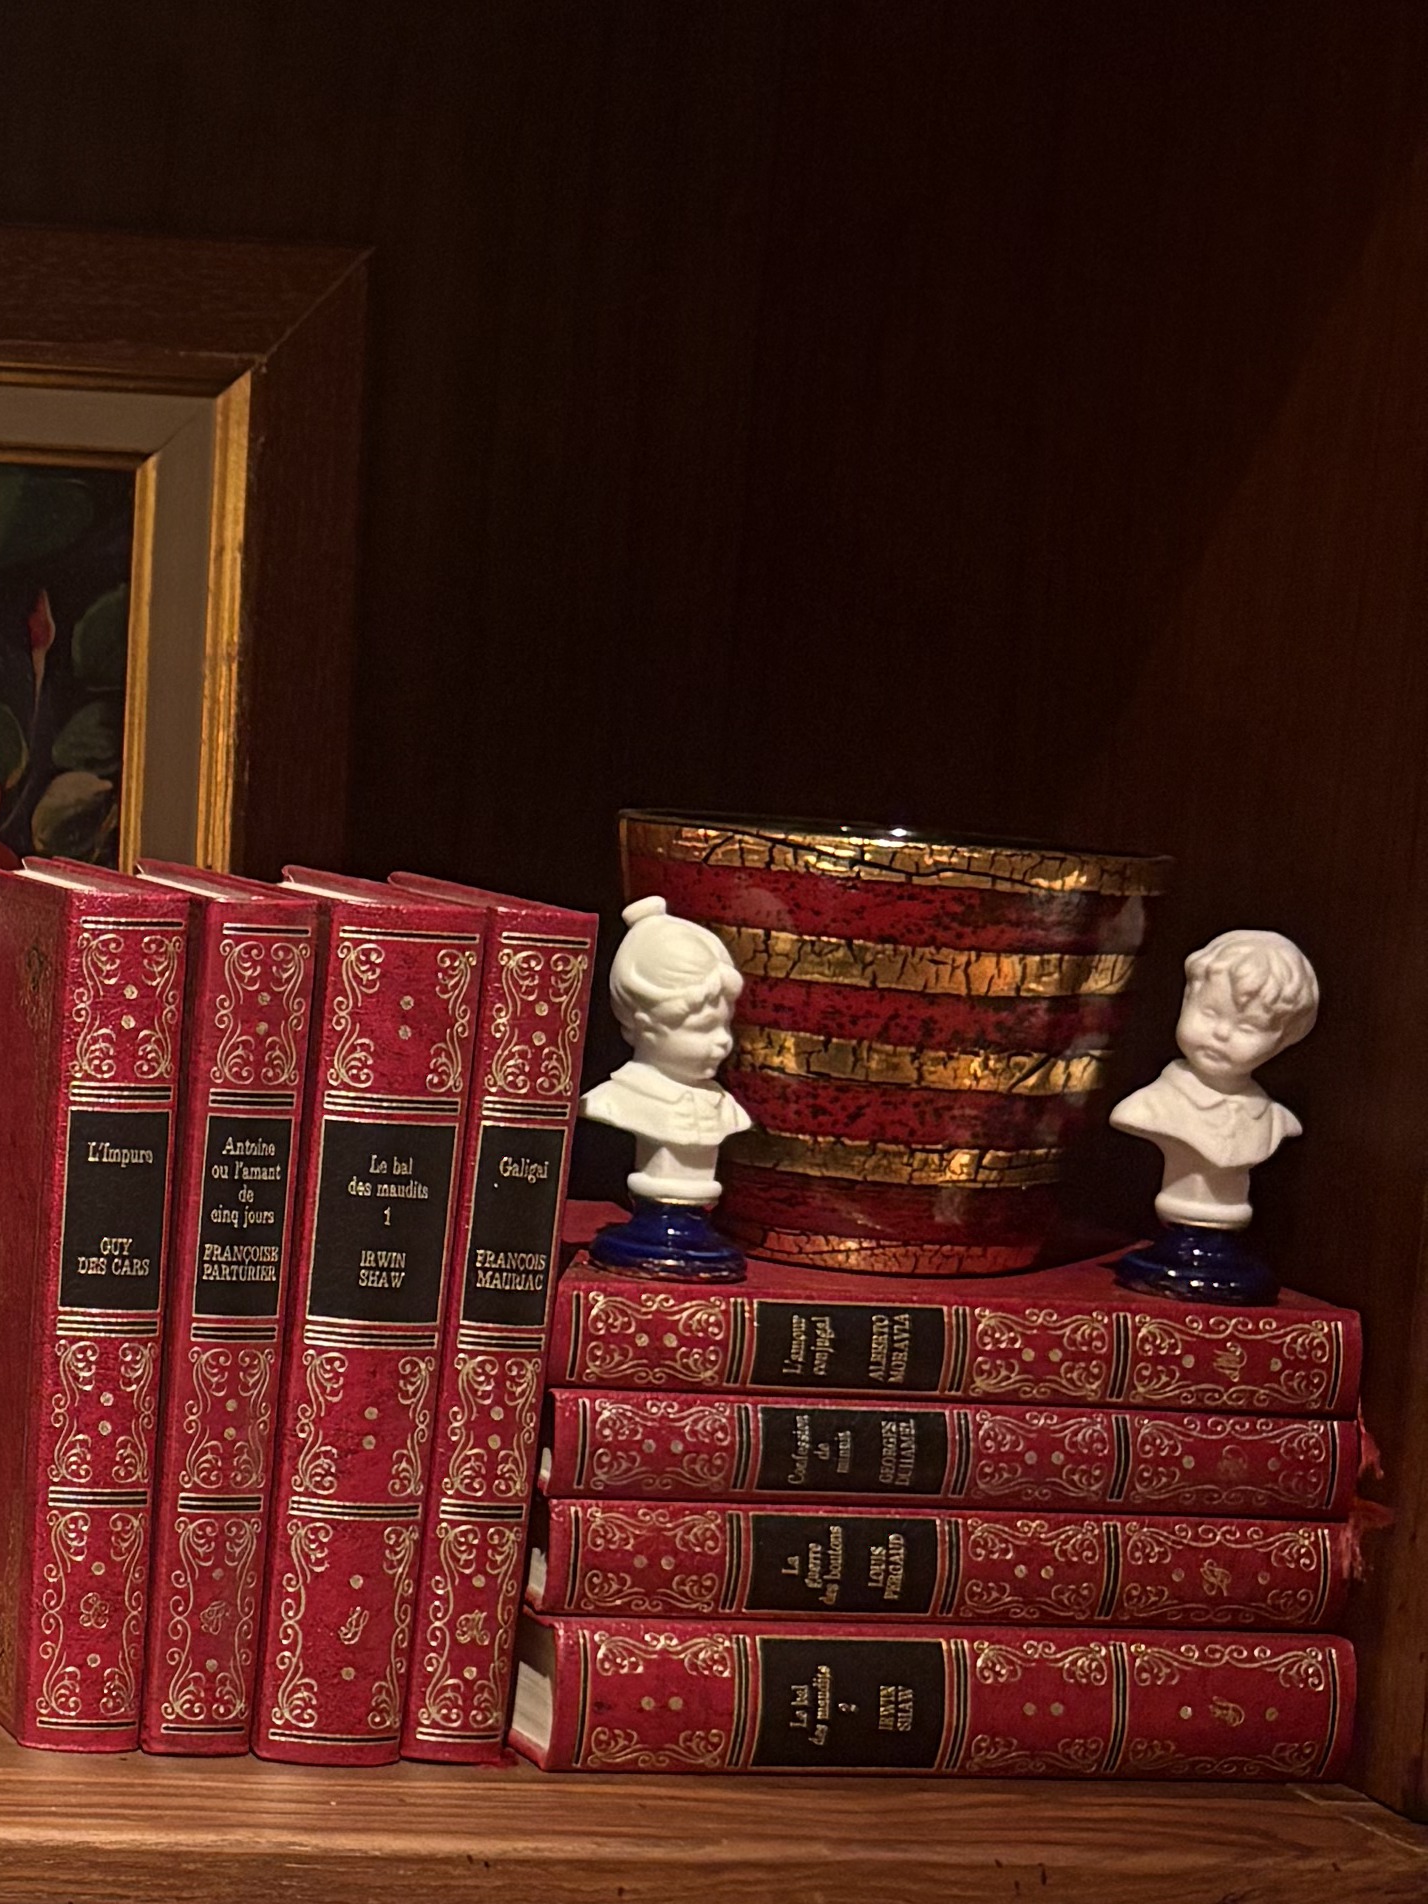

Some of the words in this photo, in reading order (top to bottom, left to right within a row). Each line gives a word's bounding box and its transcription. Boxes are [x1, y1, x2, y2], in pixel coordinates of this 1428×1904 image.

[87, 1141, 155, 1169] L'Impure
[221, 1135, 276, 1157] Antoine
[211, 1162, 230, 1180] ou
[233, 1160, 283, 1181] l'amant
[368, 1154, 389, 1174] Le
[393, 1156, 414, 1176] bal
[237, 1183, 255, 1203] de
[347, 1175, 372, 1197] des
[375, 1178, 430, 1200] maudits
[209, 1203, 240, 1230] cinq
[242, 1204, 276, 1230] jours
[383, 1205, 392, 1227] 1
[99, 1236, 134, 1257] GUY
[202, 1243, 280, 1265] FRANÇOISE
[76, 1256, 108, 1276] DES
[110, 1257, 151, 1277] CARS
[359, 1249, 407, 1270] IRWIN
[474, 1249, 549, 1272] FRANÇOIS
[201, 1262, 278, 1283] PARTURIER
[358, 1268, 407, 1290] SHAW
[474, 1269, 545, 1292] MAURIAC
[782, 1314, 806, 1374] L'amour
[809, 1315, 836, 1377] conjugal
[867, 1314, 890, 1383] ALBERTO
[887, 1313, 911, 1385] MORAVIA
[786, 1414, 810, 1486] Confession
[812, 1441, 831, 1461] de
[878, 1419, 898, 1485] GEORGES
[894, 1417, 916, 1487] DUHAMEL
[822, 1524, 844, 1581] boutons
[780, 1555, 801, 1577] La
[804, 1542, 825, 1590] guerre
[866, 1545, 887, 1588] LOUIS
[882, 1532, 906, 1600] PERGAUD
[817, 1583, 841, 1607] des
[789, 1684, 811, 1707] bal
[812, 1664, 833, 1721] maudits
[788, 1709, 809, 1729] Le
[877, 1684, 898, 1731] IRWIN
[896, 1684, 914, 1733] SHAW
[806, 1723, 830, 1747] des
